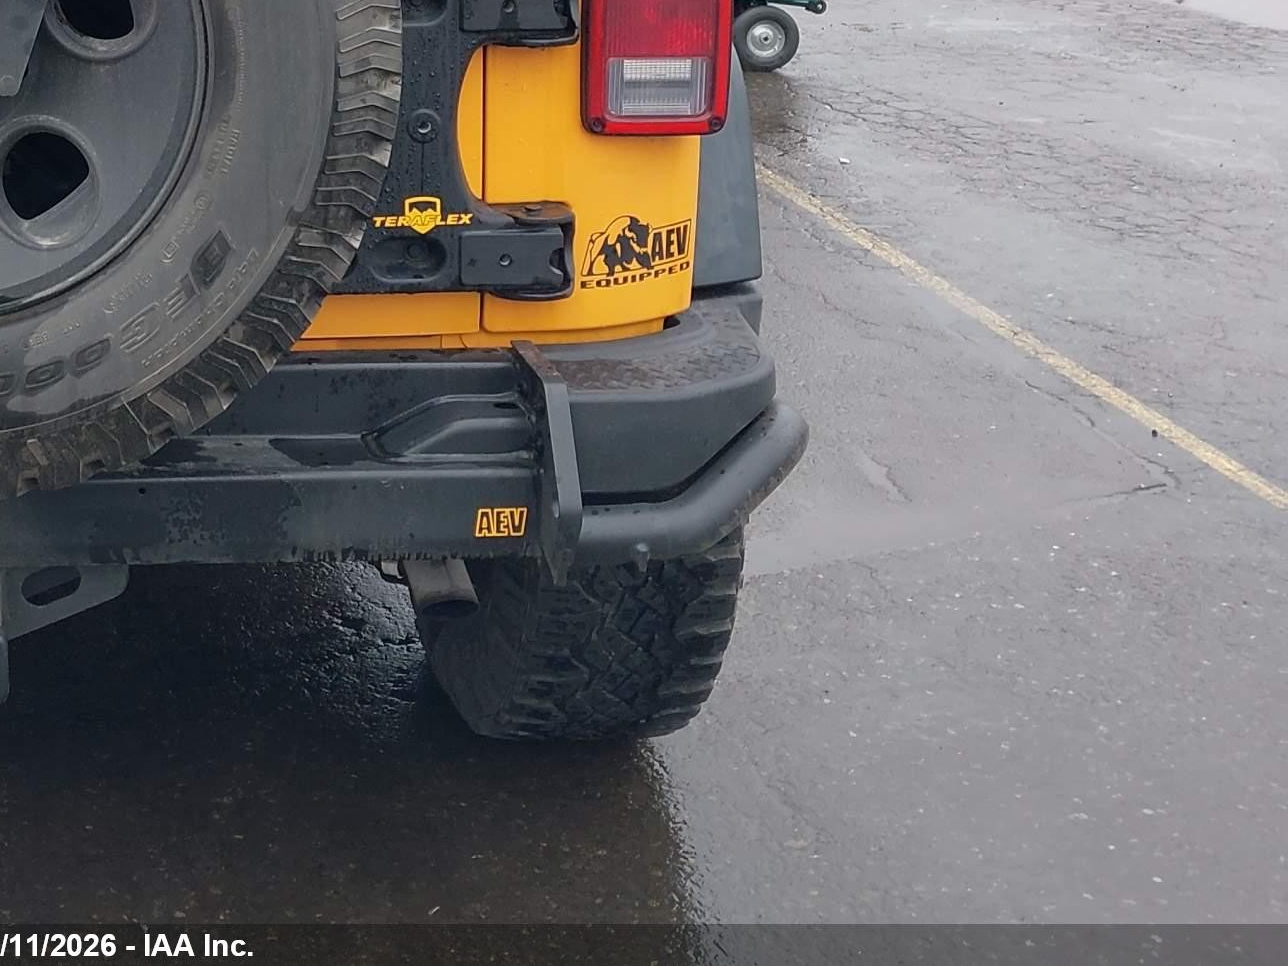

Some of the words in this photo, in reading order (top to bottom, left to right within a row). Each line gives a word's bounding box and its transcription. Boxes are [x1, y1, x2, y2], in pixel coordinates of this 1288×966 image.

[372, 213, 473, 227] TERAFLEX
[651, 226, 689, 262] AEV
[580, 261, 690, 289] EQUIPPED
[475, 507, 528, 538] AEV
